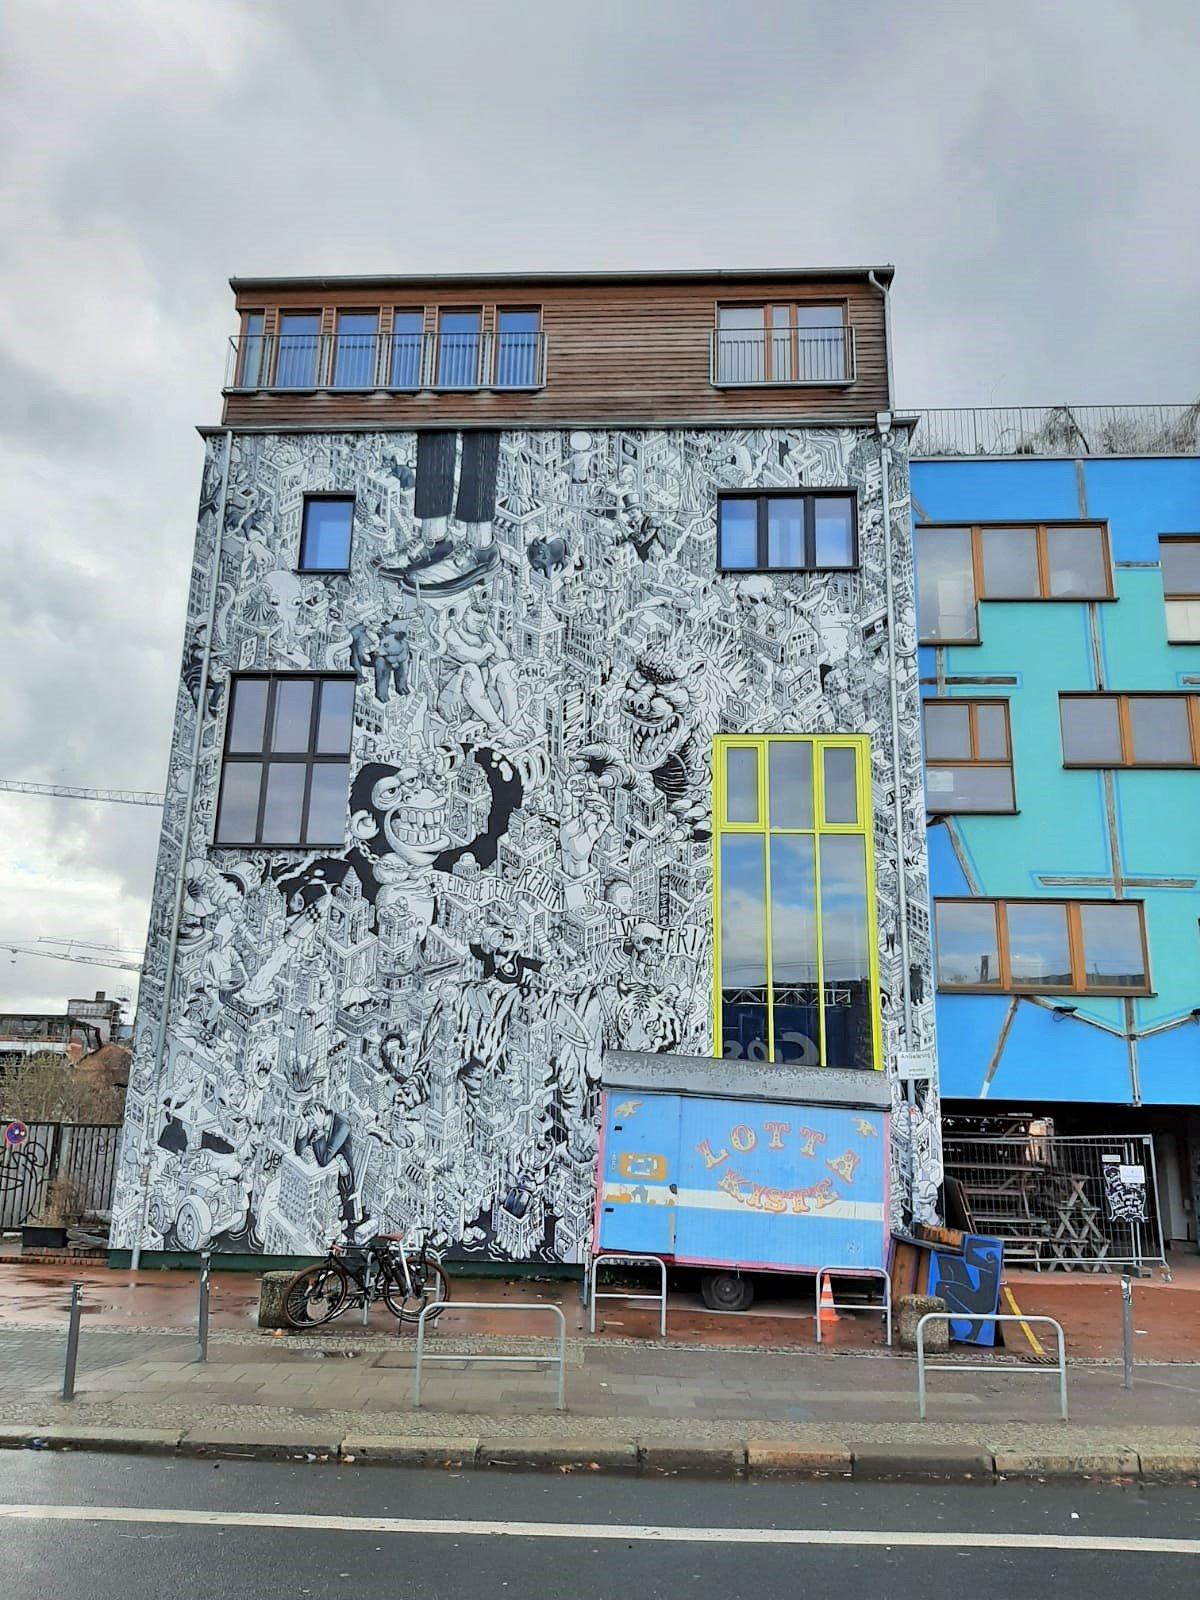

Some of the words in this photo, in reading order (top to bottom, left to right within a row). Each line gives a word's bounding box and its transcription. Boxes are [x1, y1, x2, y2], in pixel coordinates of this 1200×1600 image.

[567, 644, 596, 667] BERLIN
[518, 667, 546, 680] PENG
[376, 749, 402, 763] PUFF
[569, 779, 587, 793] 25
[448, 875, 485, 902] EINZIGE
[697, 1120, 861, 1184] LOTTA
[718, 1168, 842, 1213] KISTE
